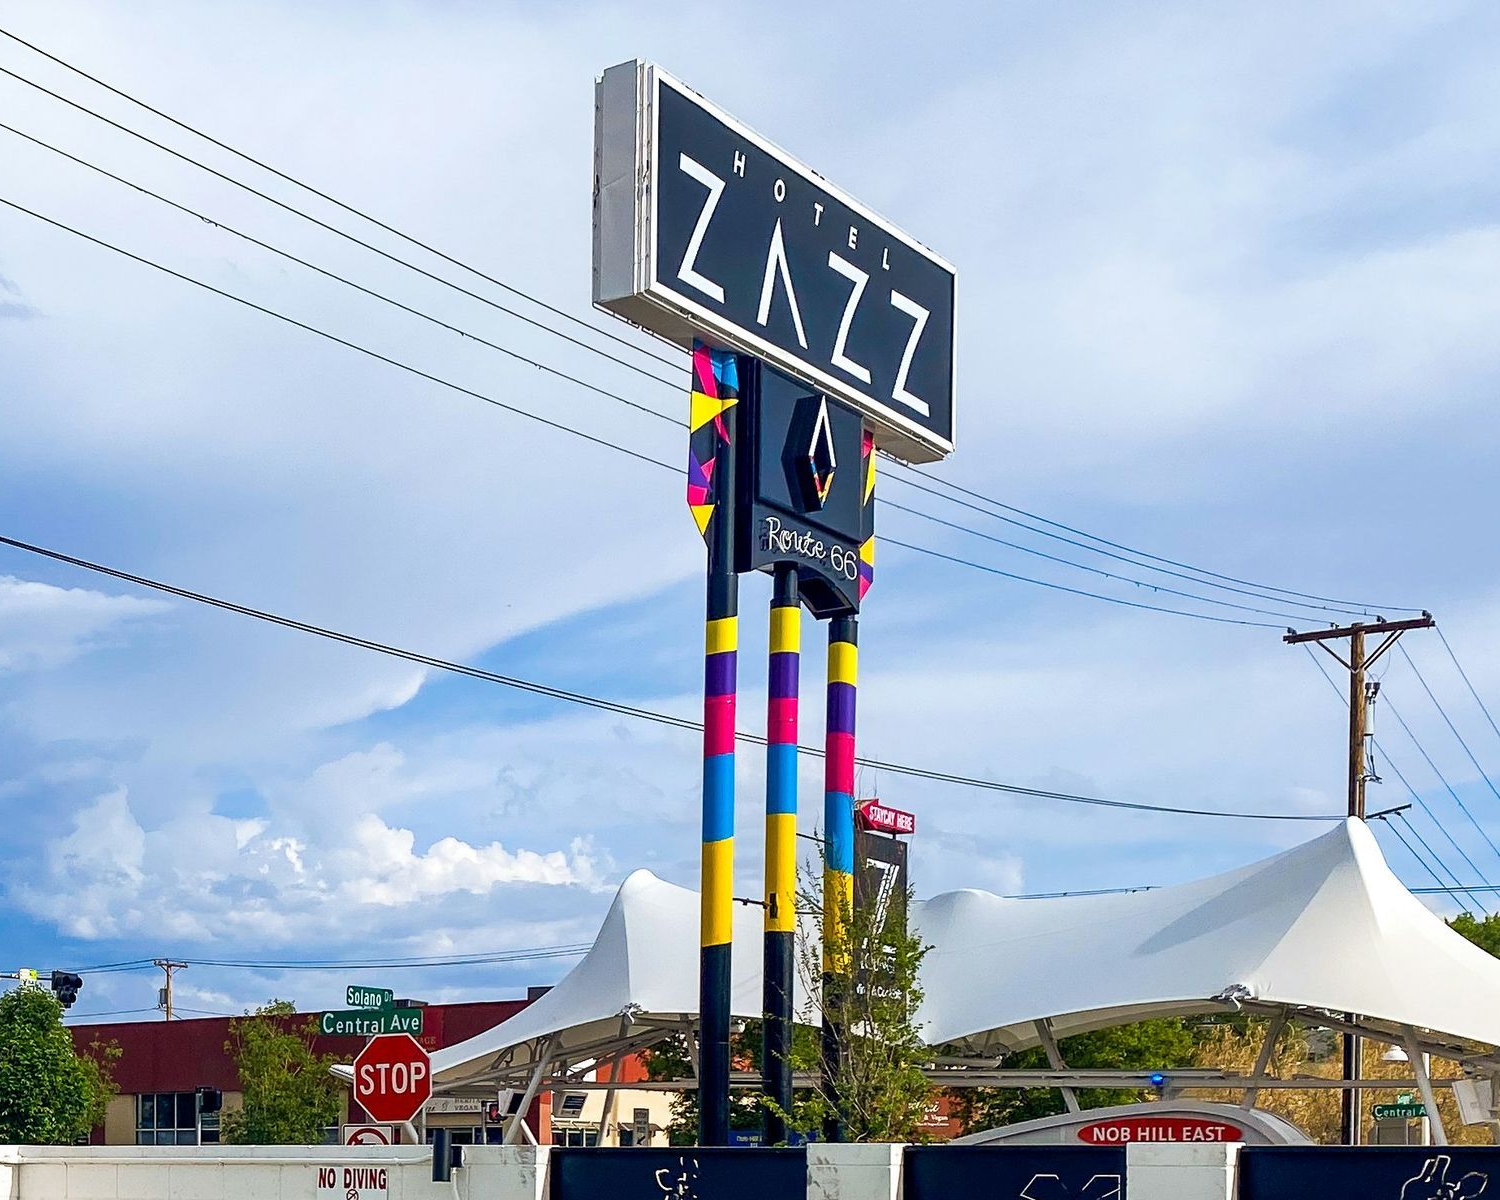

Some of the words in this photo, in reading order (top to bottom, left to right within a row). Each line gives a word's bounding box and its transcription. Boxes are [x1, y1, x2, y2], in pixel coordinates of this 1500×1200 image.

[733, 150, 891, 271] HOTEL
[765, 516, 827, 560] Route
[830, 545, 858, 581] 66
[347, 987, 382, 1007] Solano
[384, 991, 393, 1003] Dr
[322, 1013, 385, 1034] Central
[390, 1014, 420, 1031] Ave
[359, 1061, 427, 1096] STOP
[1374, 1106, 1416, 1118] Central
[1092, 1126, 1131, 1142] NOB
[1137, 1126, 1177, 1142] HILL
[1182, 1126, 1226, 1142] EAST
[318, 1167, 336, 1189] NO
[343, 1167, 387, 1190] DIVING
